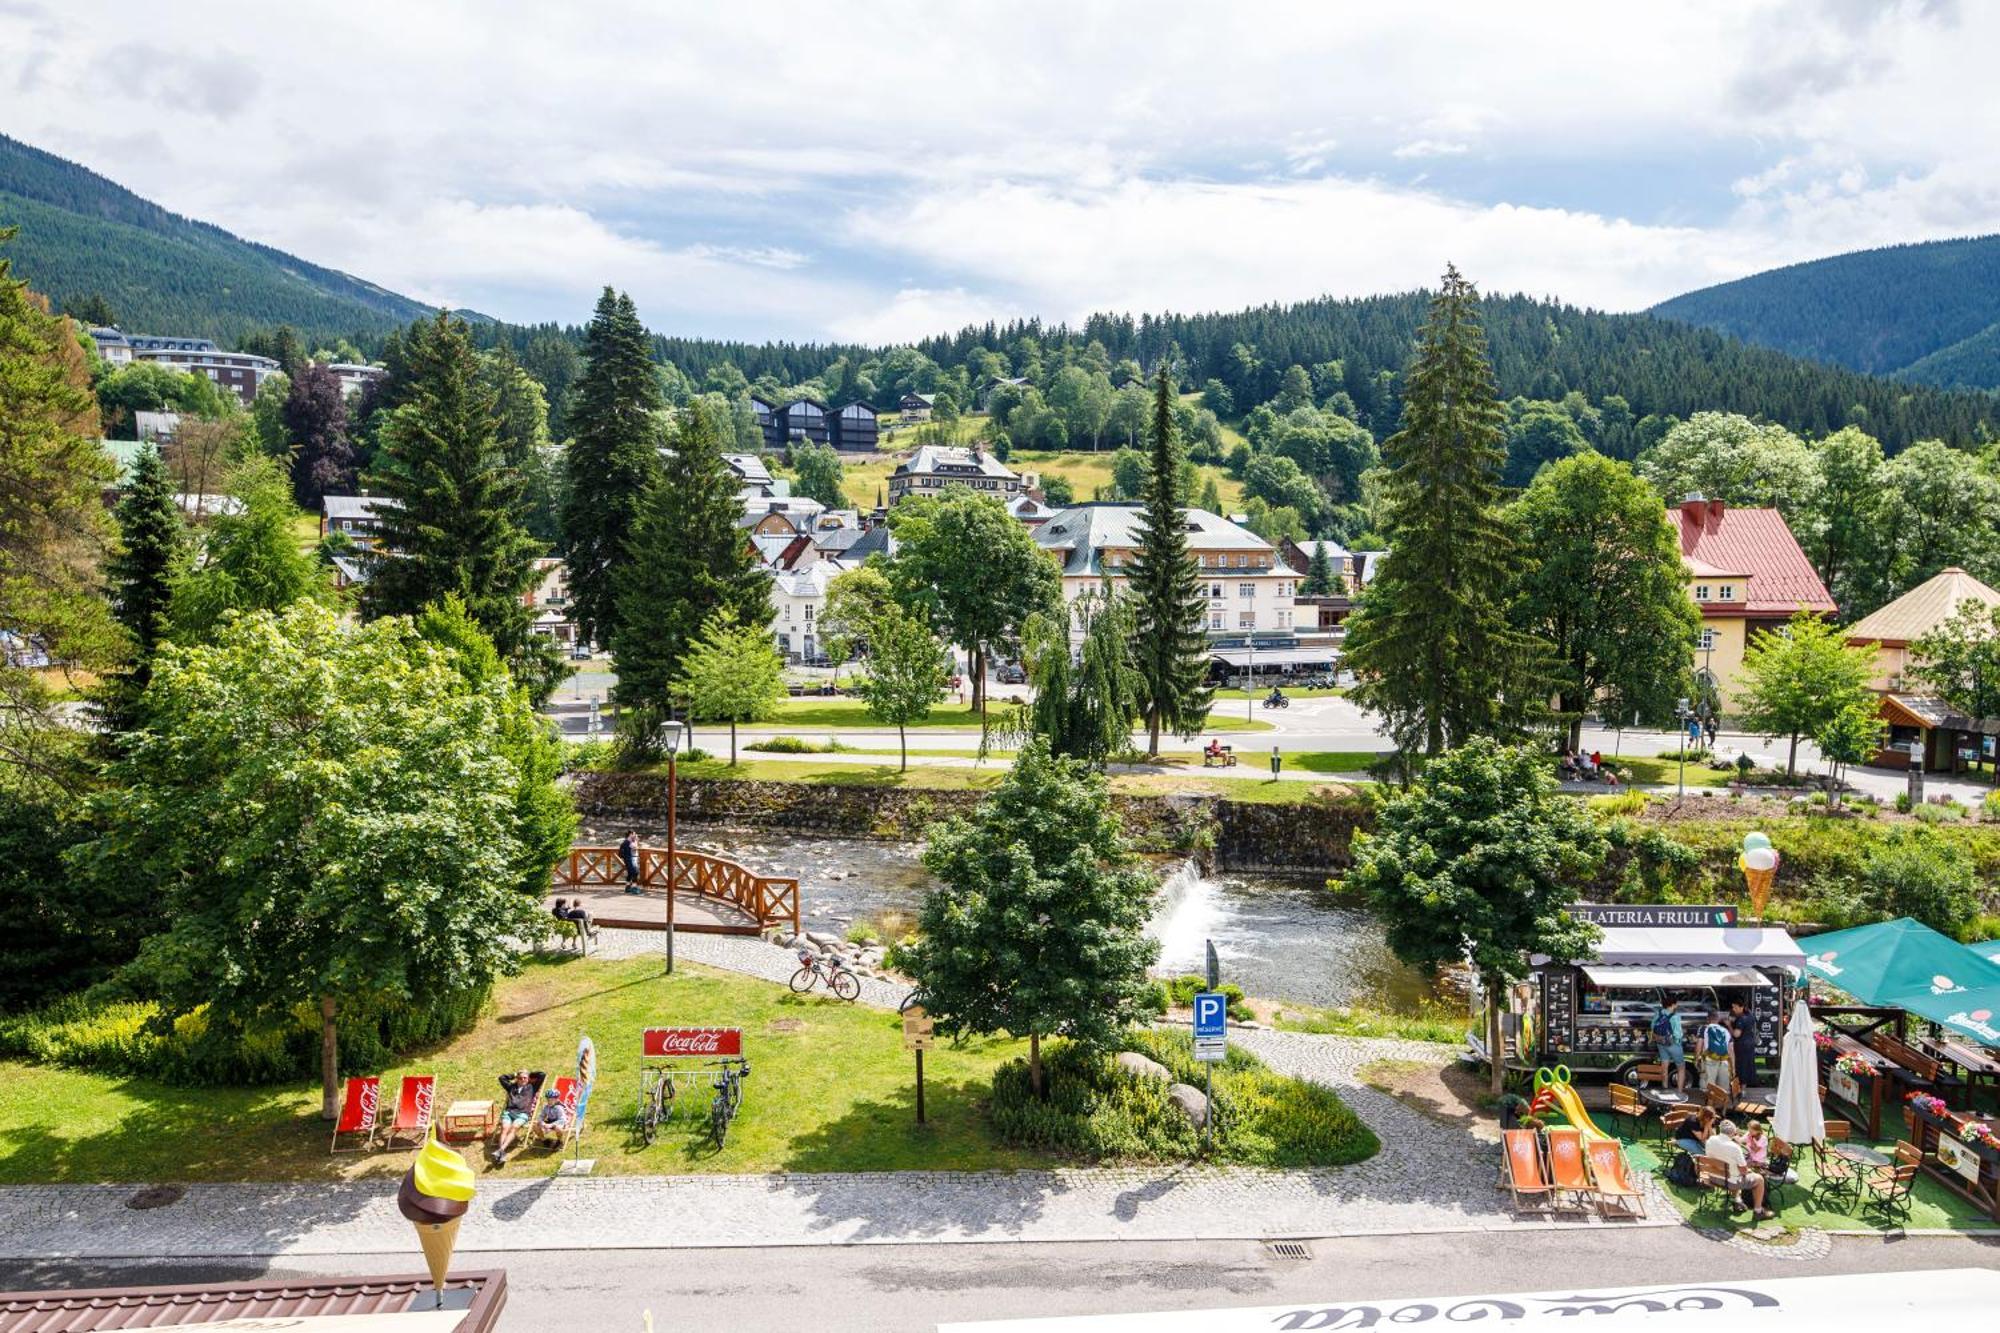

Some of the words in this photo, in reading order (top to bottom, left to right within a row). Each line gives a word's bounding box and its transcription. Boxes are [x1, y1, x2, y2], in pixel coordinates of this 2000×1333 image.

[1569, 911, 1653, 924] ELATERIA
[1658, 911, 1709, 924] FRIULI
[1201, 1000, 1219, 1024] P
